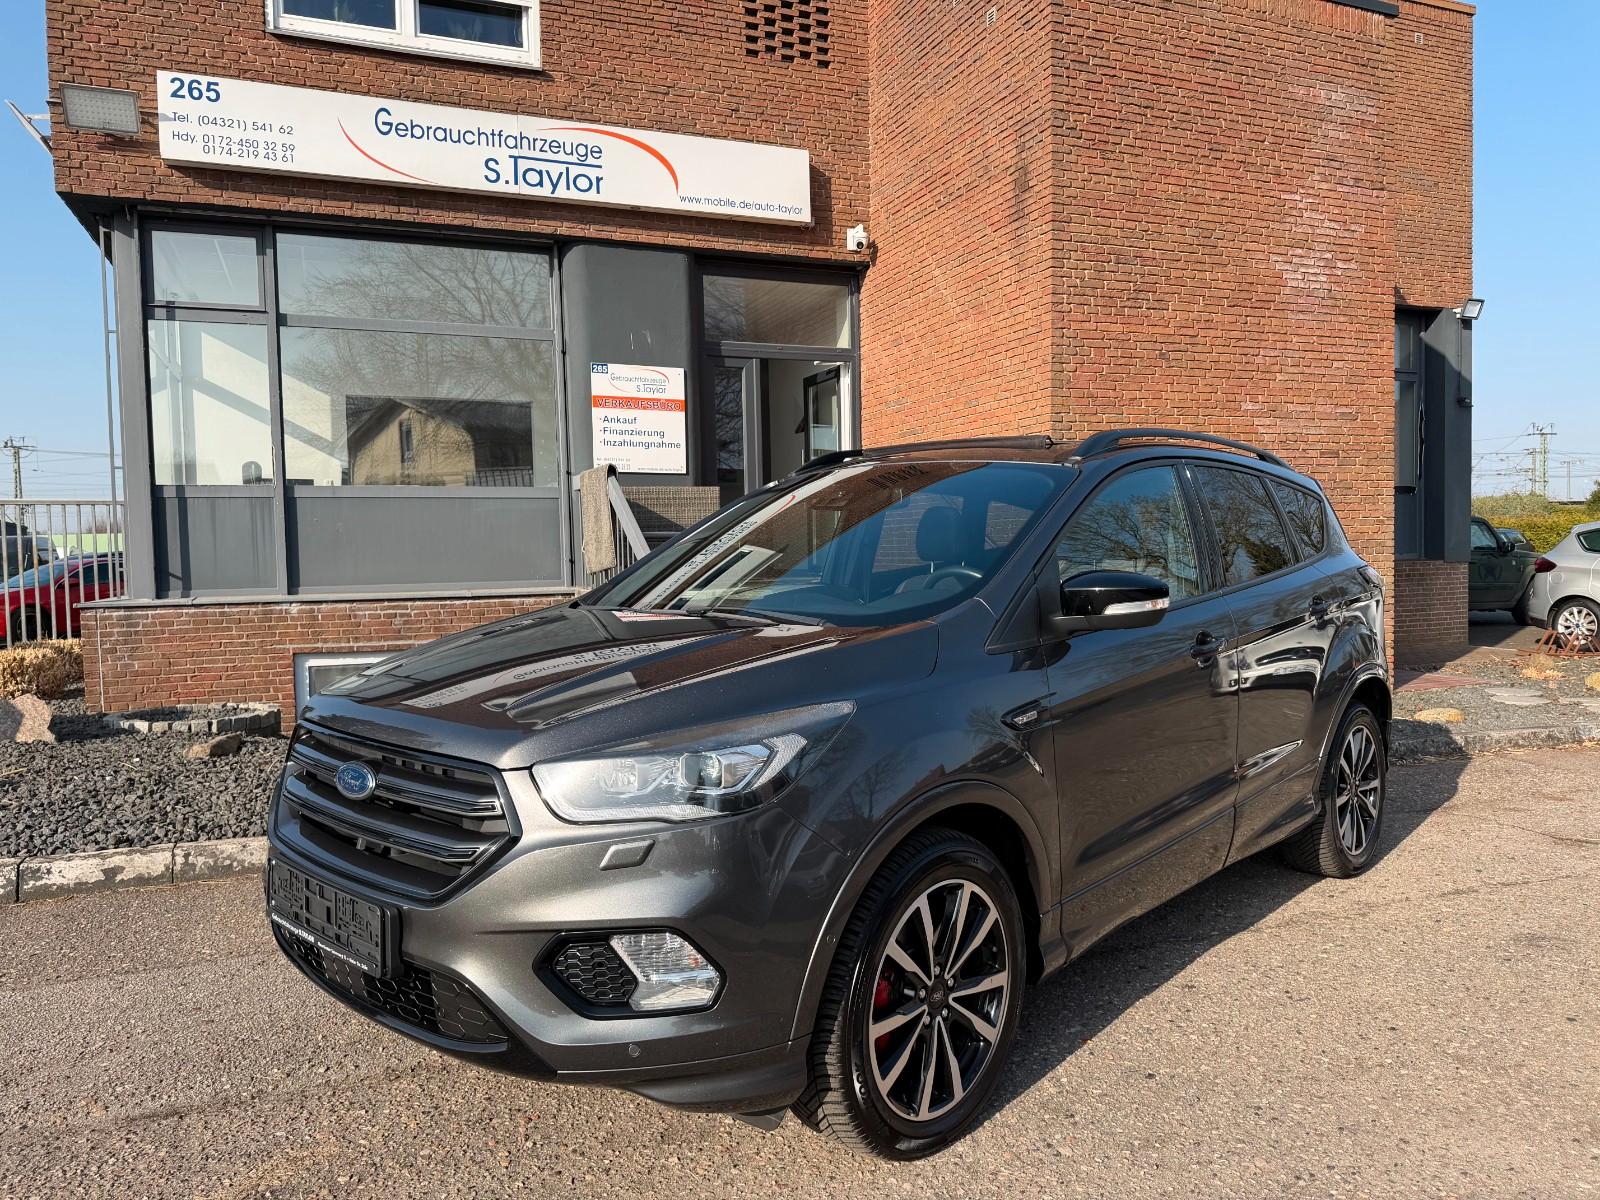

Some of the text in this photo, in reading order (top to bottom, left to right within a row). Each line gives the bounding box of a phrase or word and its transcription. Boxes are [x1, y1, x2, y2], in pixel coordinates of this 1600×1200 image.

[169, 76, 221, 103] 265
[172, 111, 294, 135] Tel. (04321) 541 62
[172, 130, 296, 153] Hdy. 0172-450 32 59
[374, 107, 603, 162] Gebrauchtfahrzeuge
[202, 144, 295, 164] 0174-219 43 61
[484, 154, 603, 195] S.Taylor
[679, 194, 803, 215] www.mobile.de/auto-taylor
[592, 364, 608, 373] 265
[603, 415, 637, 425] Ankauf
[603, 426, 665, 439] Finanzierung
[603, 438, 681, 449] Inzahlungnahme
